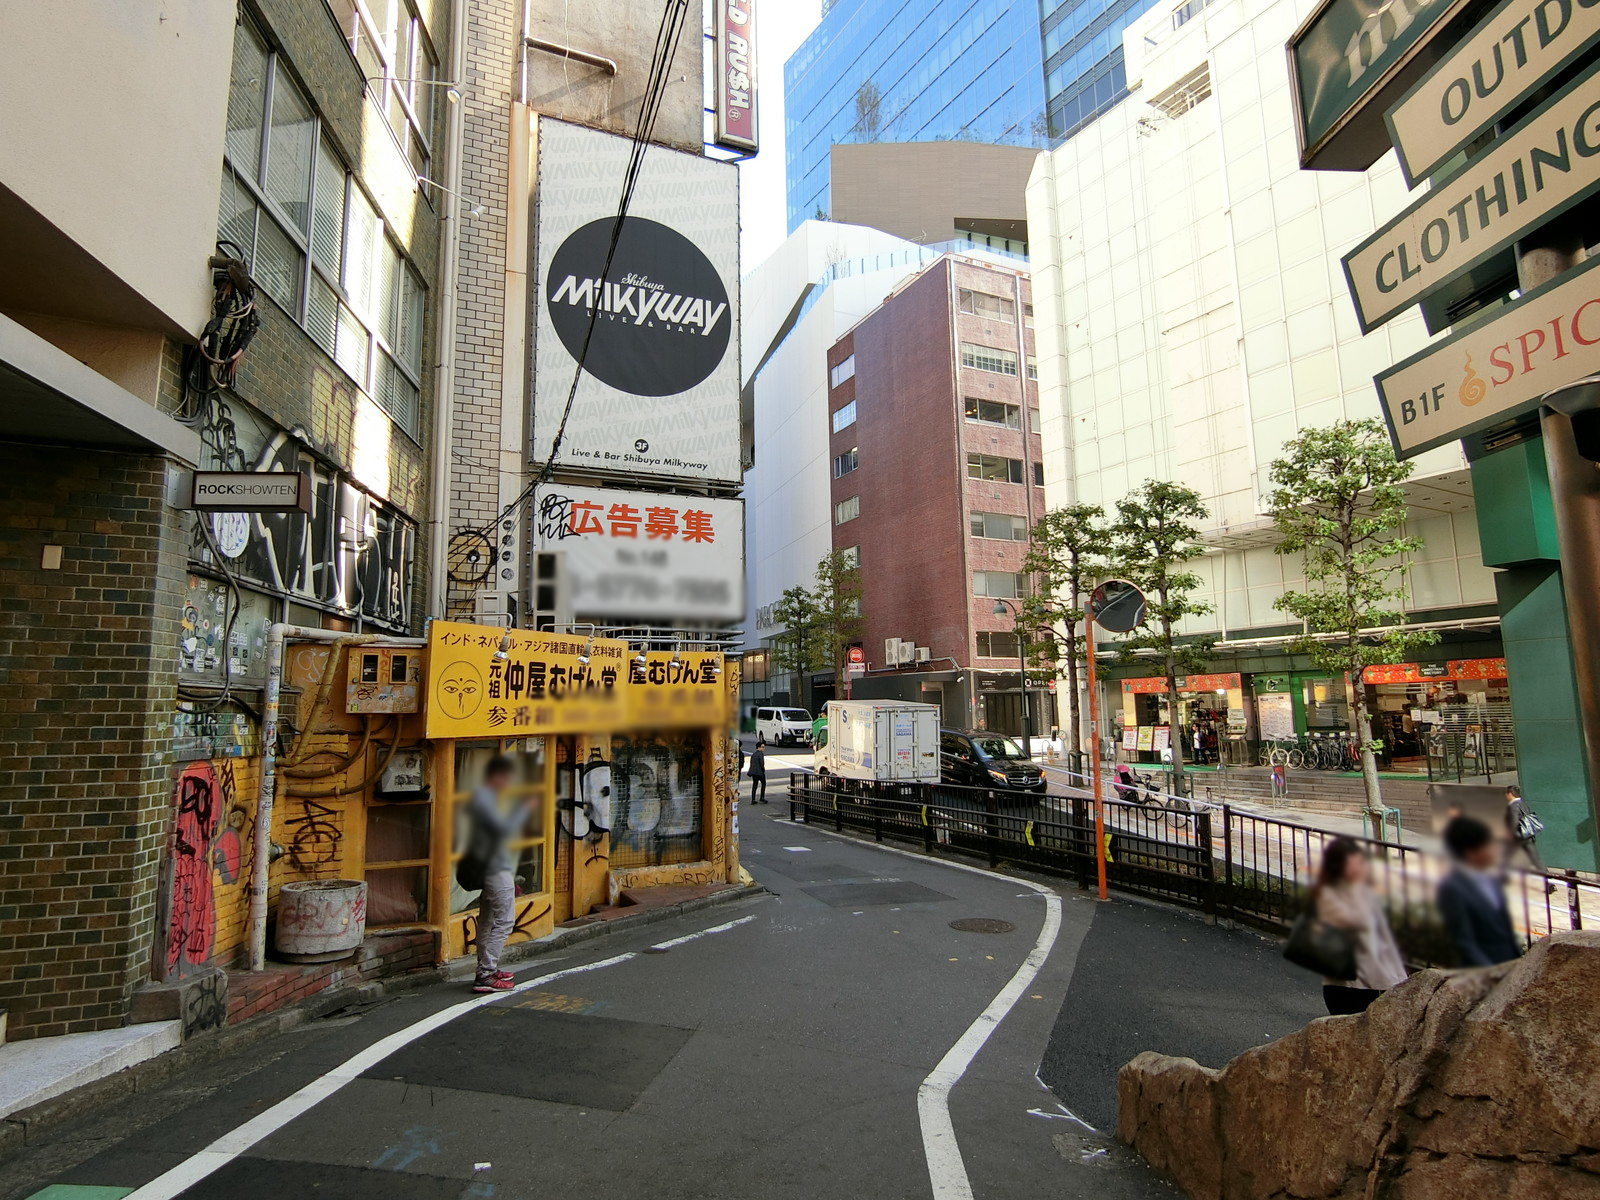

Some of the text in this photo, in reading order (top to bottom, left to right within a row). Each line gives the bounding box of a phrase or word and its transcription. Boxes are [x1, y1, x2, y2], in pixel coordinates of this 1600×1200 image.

[1440, 0, 1600, 126] OUTD
[621, 273, 665, 293] Shibuya
[586, 310, 628, 324] LIVE
[666, 325, 696, 335] BAR
[1400, 383, 1445, 425] B1F
[635, 441, 648, 451] 3F
[571, 448, 591, 459] Live
[593, 450, 601, 459] &
[604, 451, 621, 461] Bar
[624, 453, 661, 466] Shibuya
[663, 458, 708, 471] Milkyway
[198, 484, 297, 495] ROCKSHOWTEN
[566, 500, 715, 544] 広告募集
[488, 659, 501, 699] 元祖
